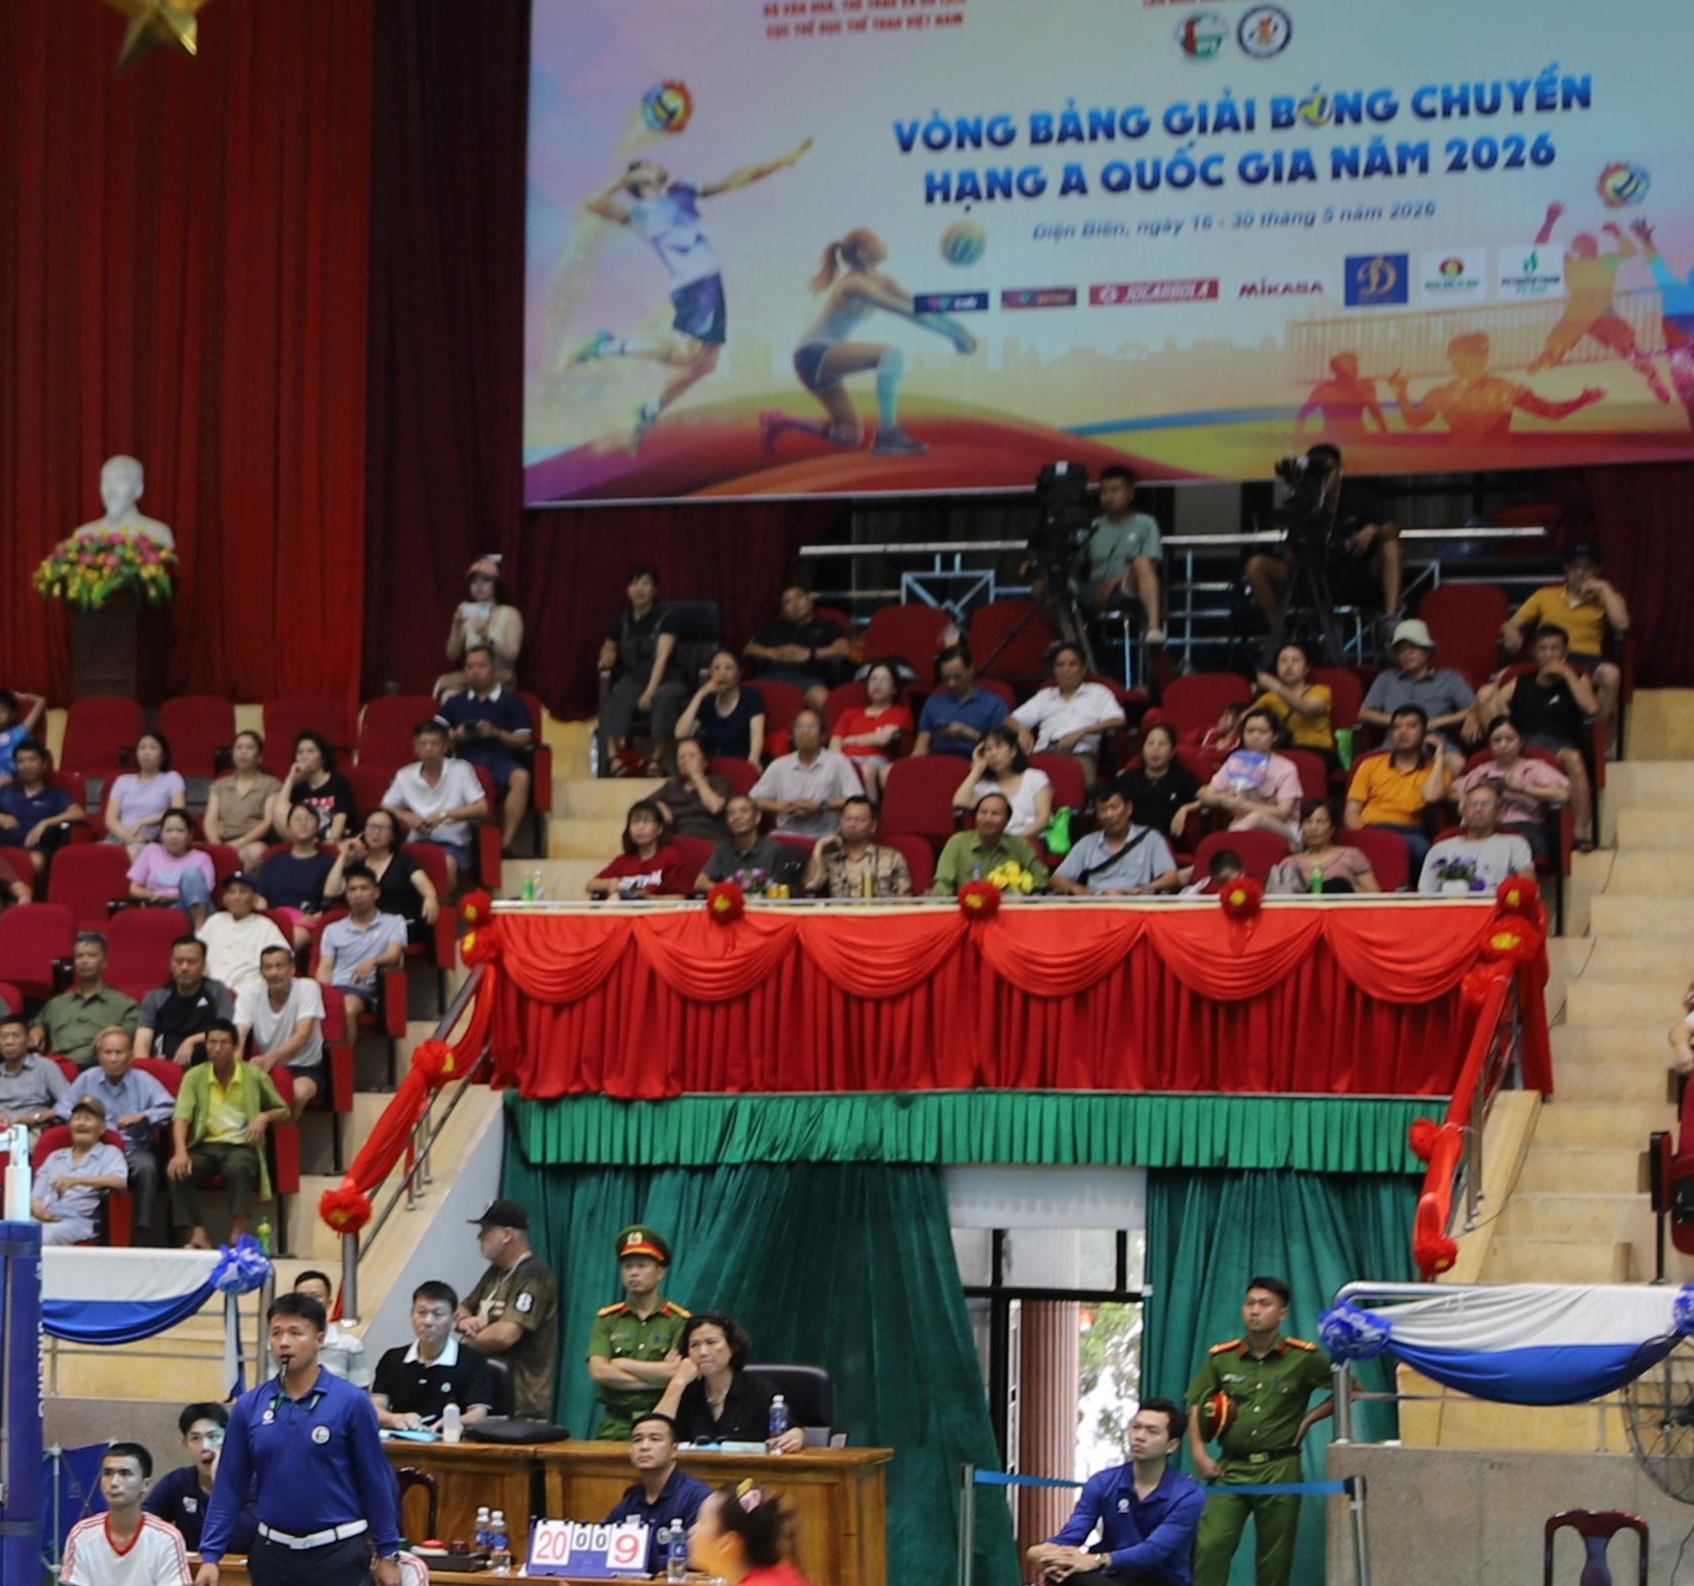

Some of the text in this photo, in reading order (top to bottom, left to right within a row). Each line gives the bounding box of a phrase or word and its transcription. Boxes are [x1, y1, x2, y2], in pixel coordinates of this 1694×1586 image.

[893, 108, 1017, 154] VÒNG
[925, 131, 1556, 213] HẠNG A QUỐC GIA NĂM 2026
[536, 1531, 639, 1564] 20 0 0 9
